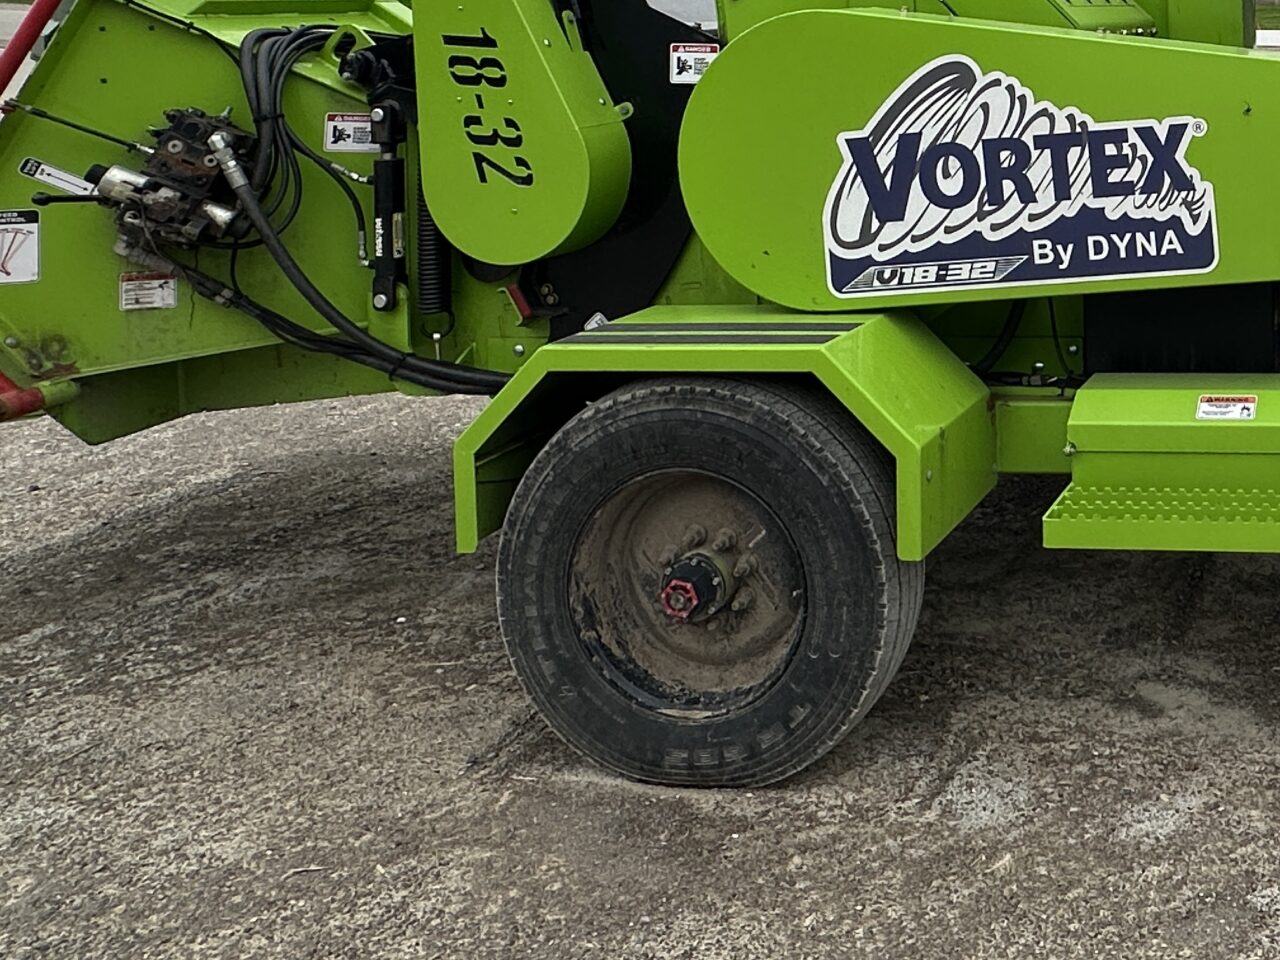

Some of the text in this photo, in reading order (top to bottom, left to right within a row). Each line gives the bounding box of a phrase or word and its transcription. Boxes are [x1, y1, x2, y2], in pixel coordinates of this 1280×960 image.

[442, 26, 533, 187] 18-32
[844, 123, 1196, 223] VORTEX
[873, 261, 997, 287] V18-32
[1032, 229, 1184, 270] By DYNA
